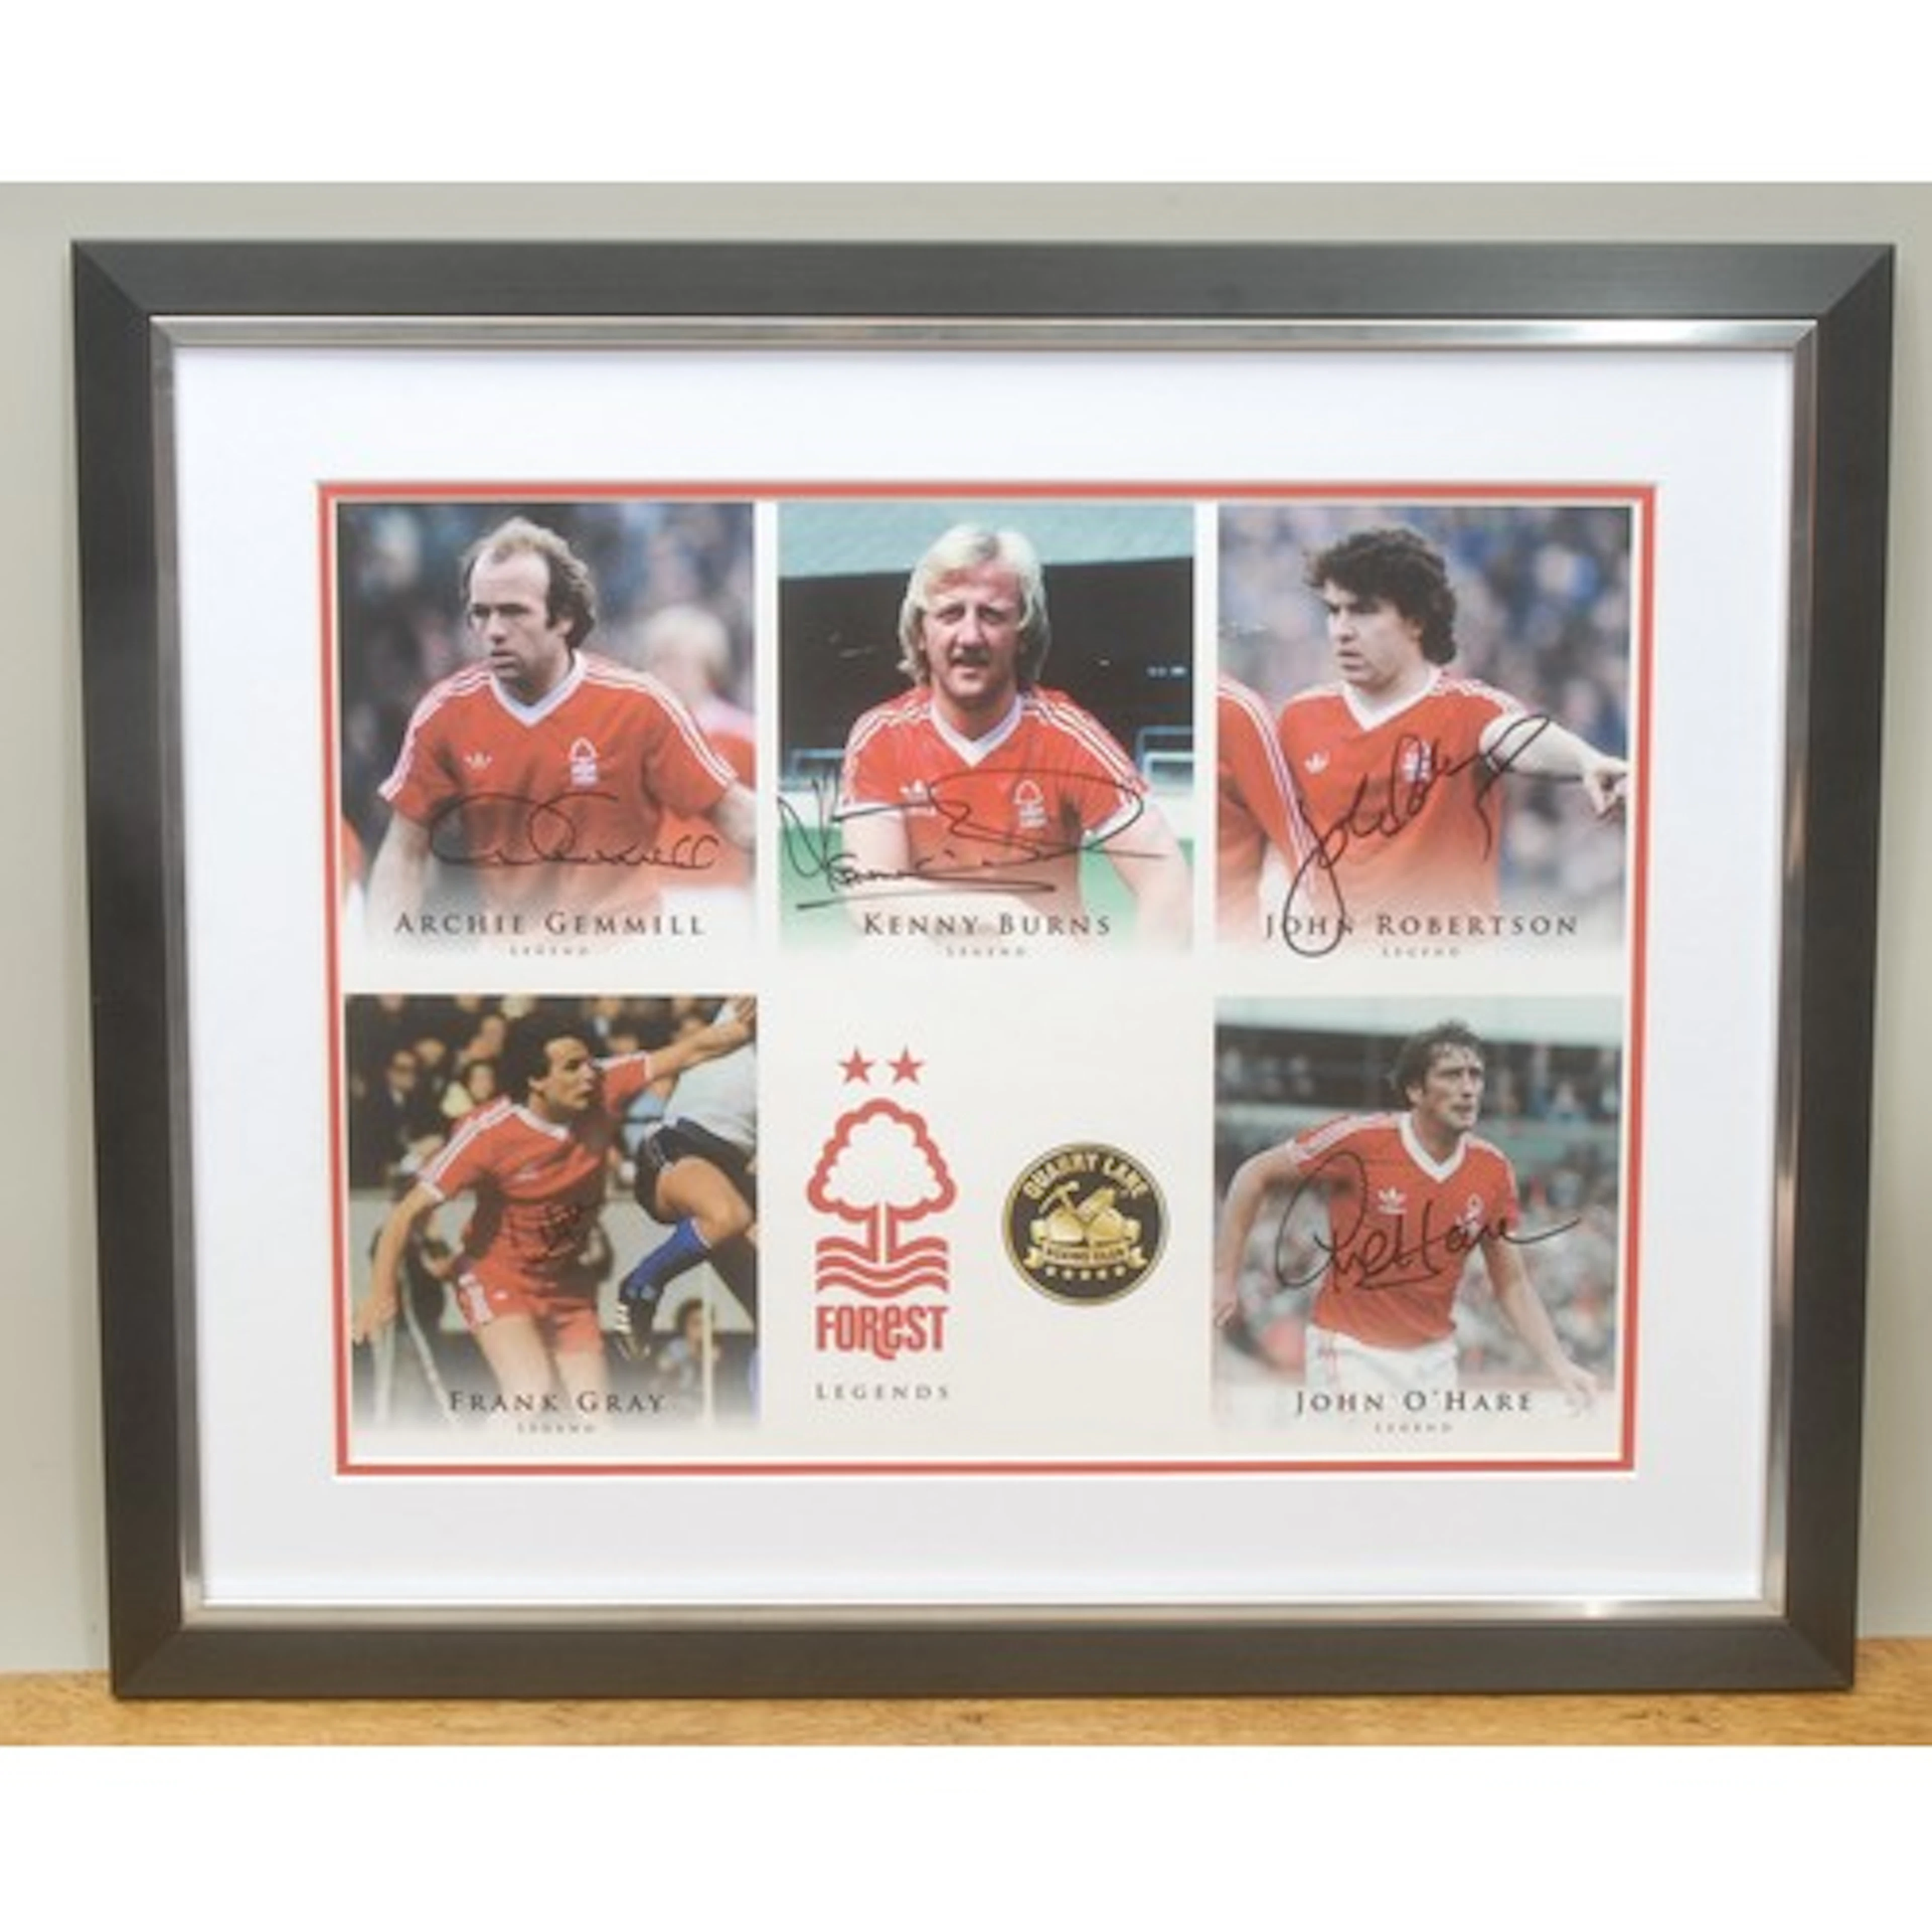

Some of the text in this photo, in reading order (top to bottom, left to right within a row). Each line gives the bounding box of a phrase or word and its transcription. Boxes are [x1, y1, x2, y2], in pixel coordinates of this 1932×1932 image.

[395, 912, 705, 936] ARCHIE GEMMILL
[863, 913, 1111, 936] KENNY BURNS
[1265, 914, 1579, 939] JOHN ROBERTSON
[449, 1390, 666, 1412] FRANK GRAY
[815, 1383, 949, 1400] LEGENDS
[1296, 1390, 1532, 1416] JOHN O'HARE
